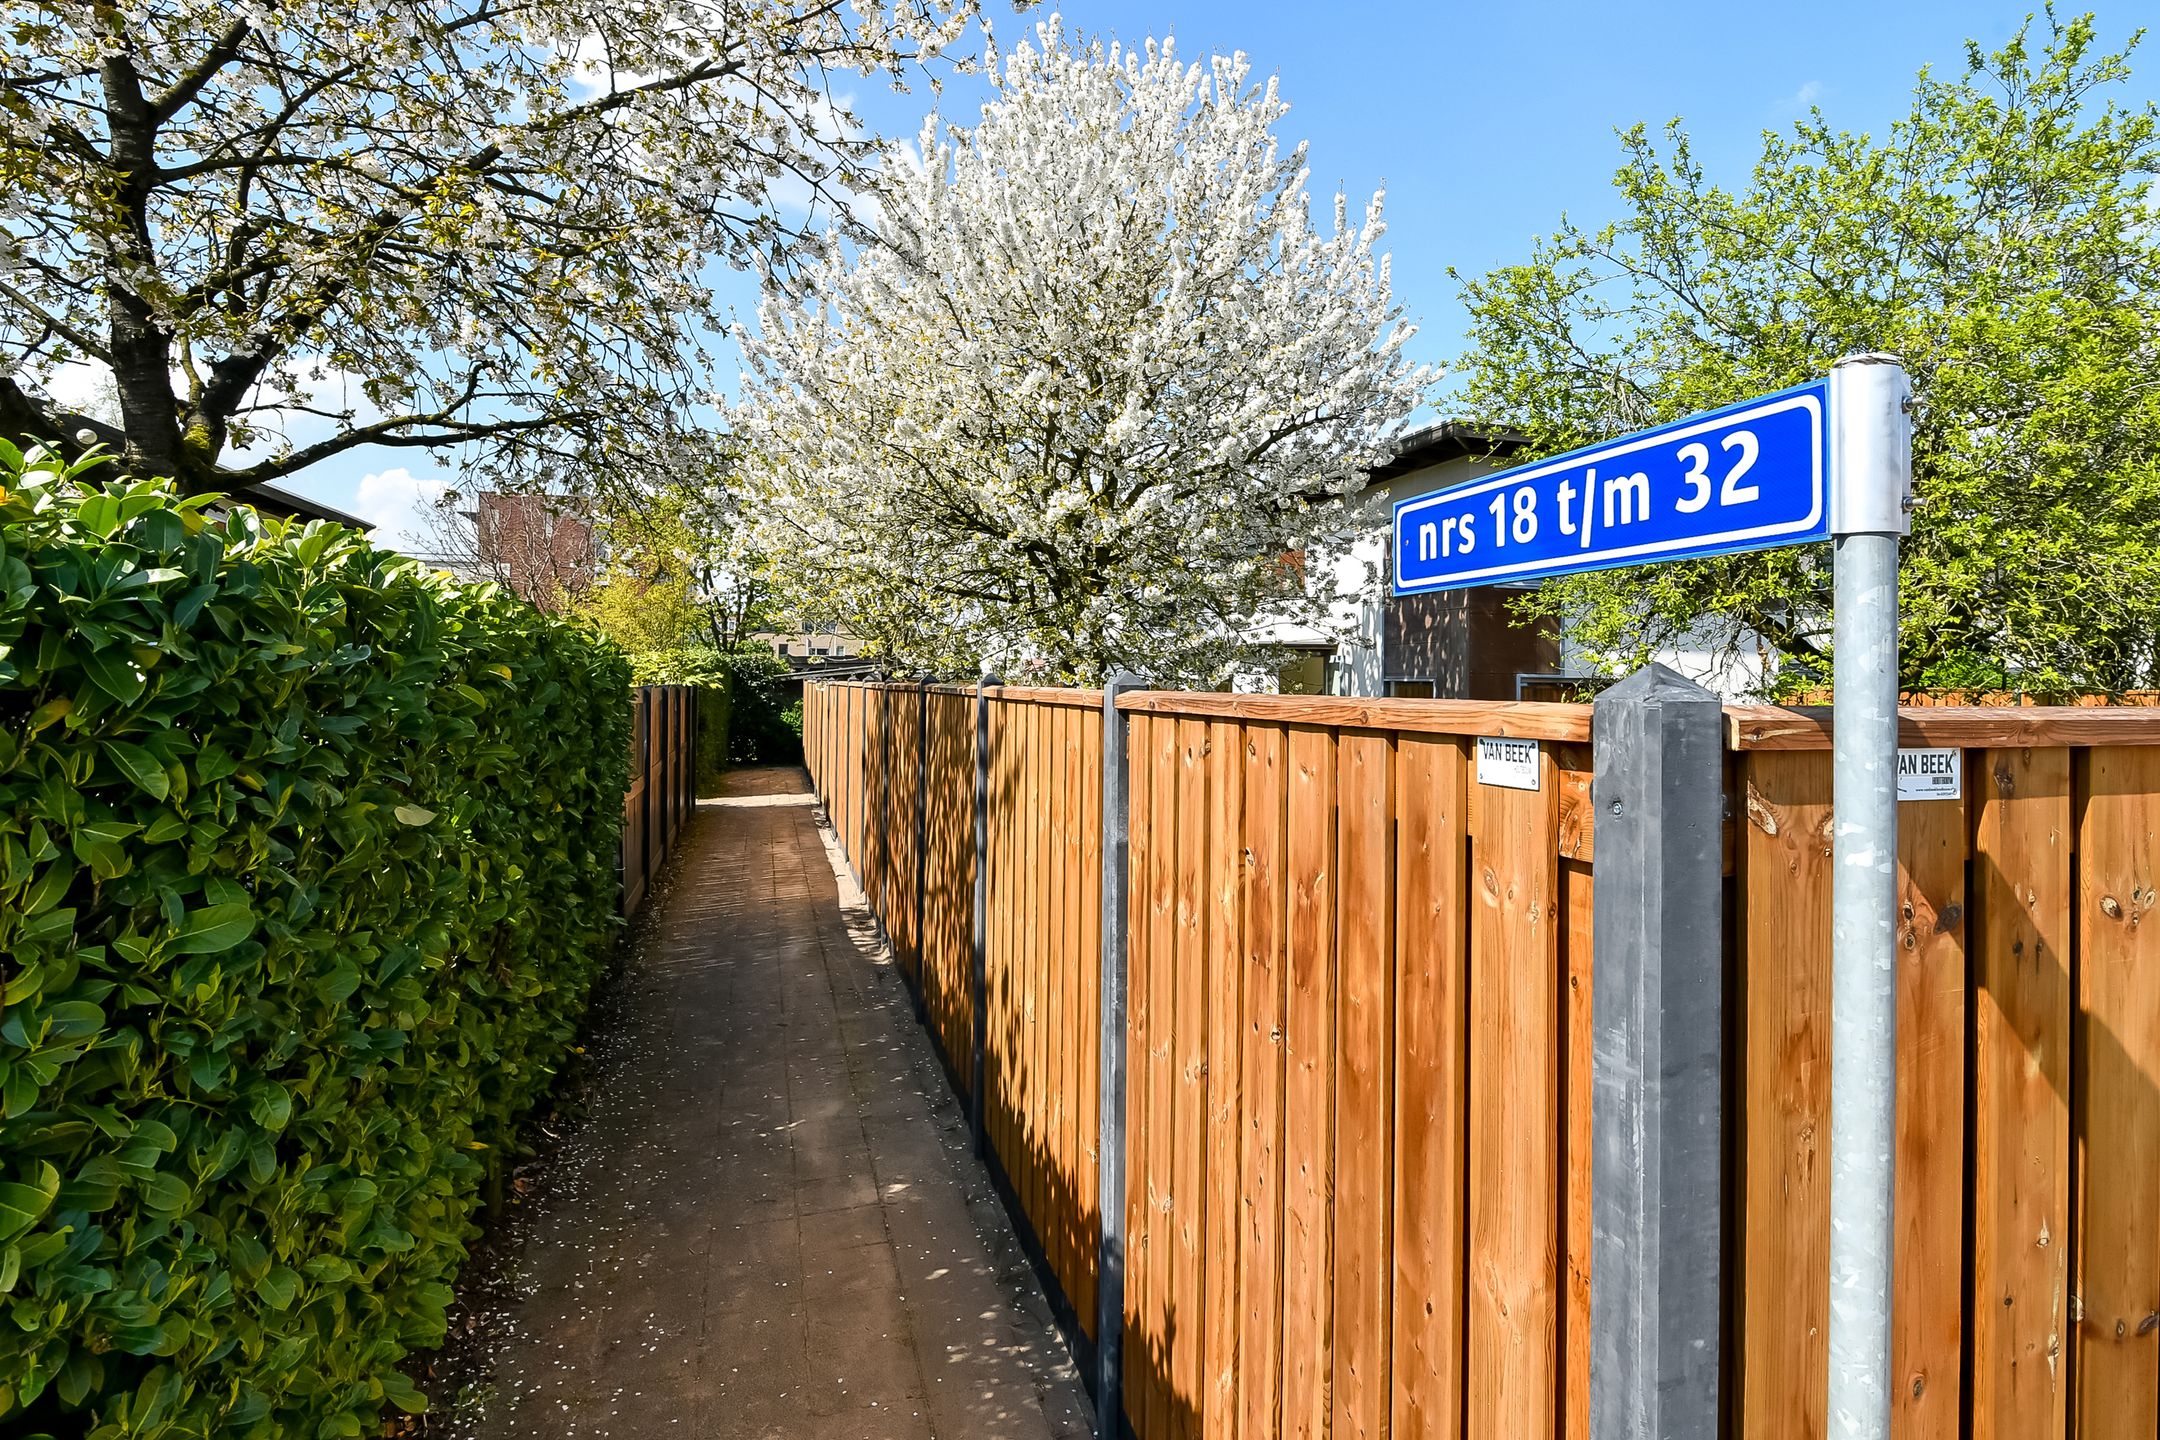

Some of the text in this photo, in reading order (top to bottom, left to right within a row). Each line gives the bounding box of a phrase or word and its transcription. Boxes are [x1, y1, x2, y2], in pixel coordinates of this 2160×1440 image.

[1419, 430, 1759, 561] nrs 18 t/m 32
[1483, 742, 1532, 764] VAN BEEK
[1921, 754, 1954, 774] BEEK
